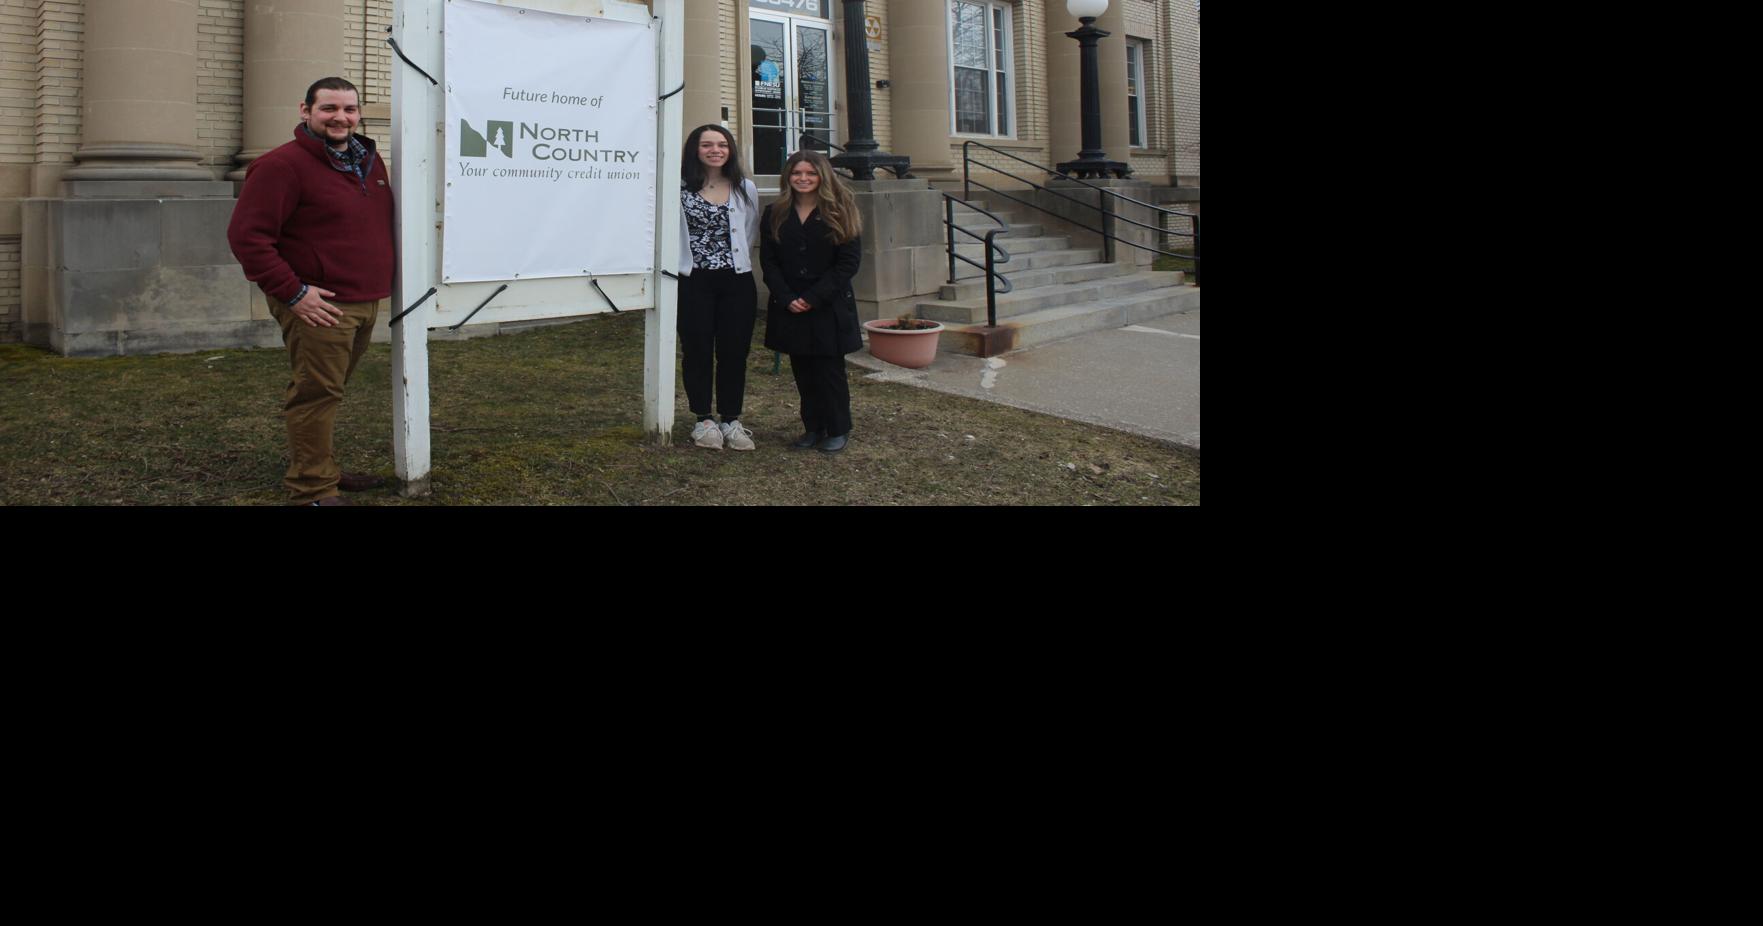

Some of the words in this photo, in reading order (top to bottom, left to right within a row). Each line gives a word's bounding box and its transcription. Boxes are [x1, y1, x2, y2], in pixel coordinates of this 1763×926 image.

[503, 87, 548, 103] Future
[552, 92, 586, 106] home
[590, 96, 604, 109] of
[520, 122, 599, 143] NORTH
[532, 143, 640, 163] COUNTRY
[459, 162, 489, 177] Your
[492, 166, 563, 182] community
[567, 166, 602, 180] credit
[607, 170, 641, 180] union
